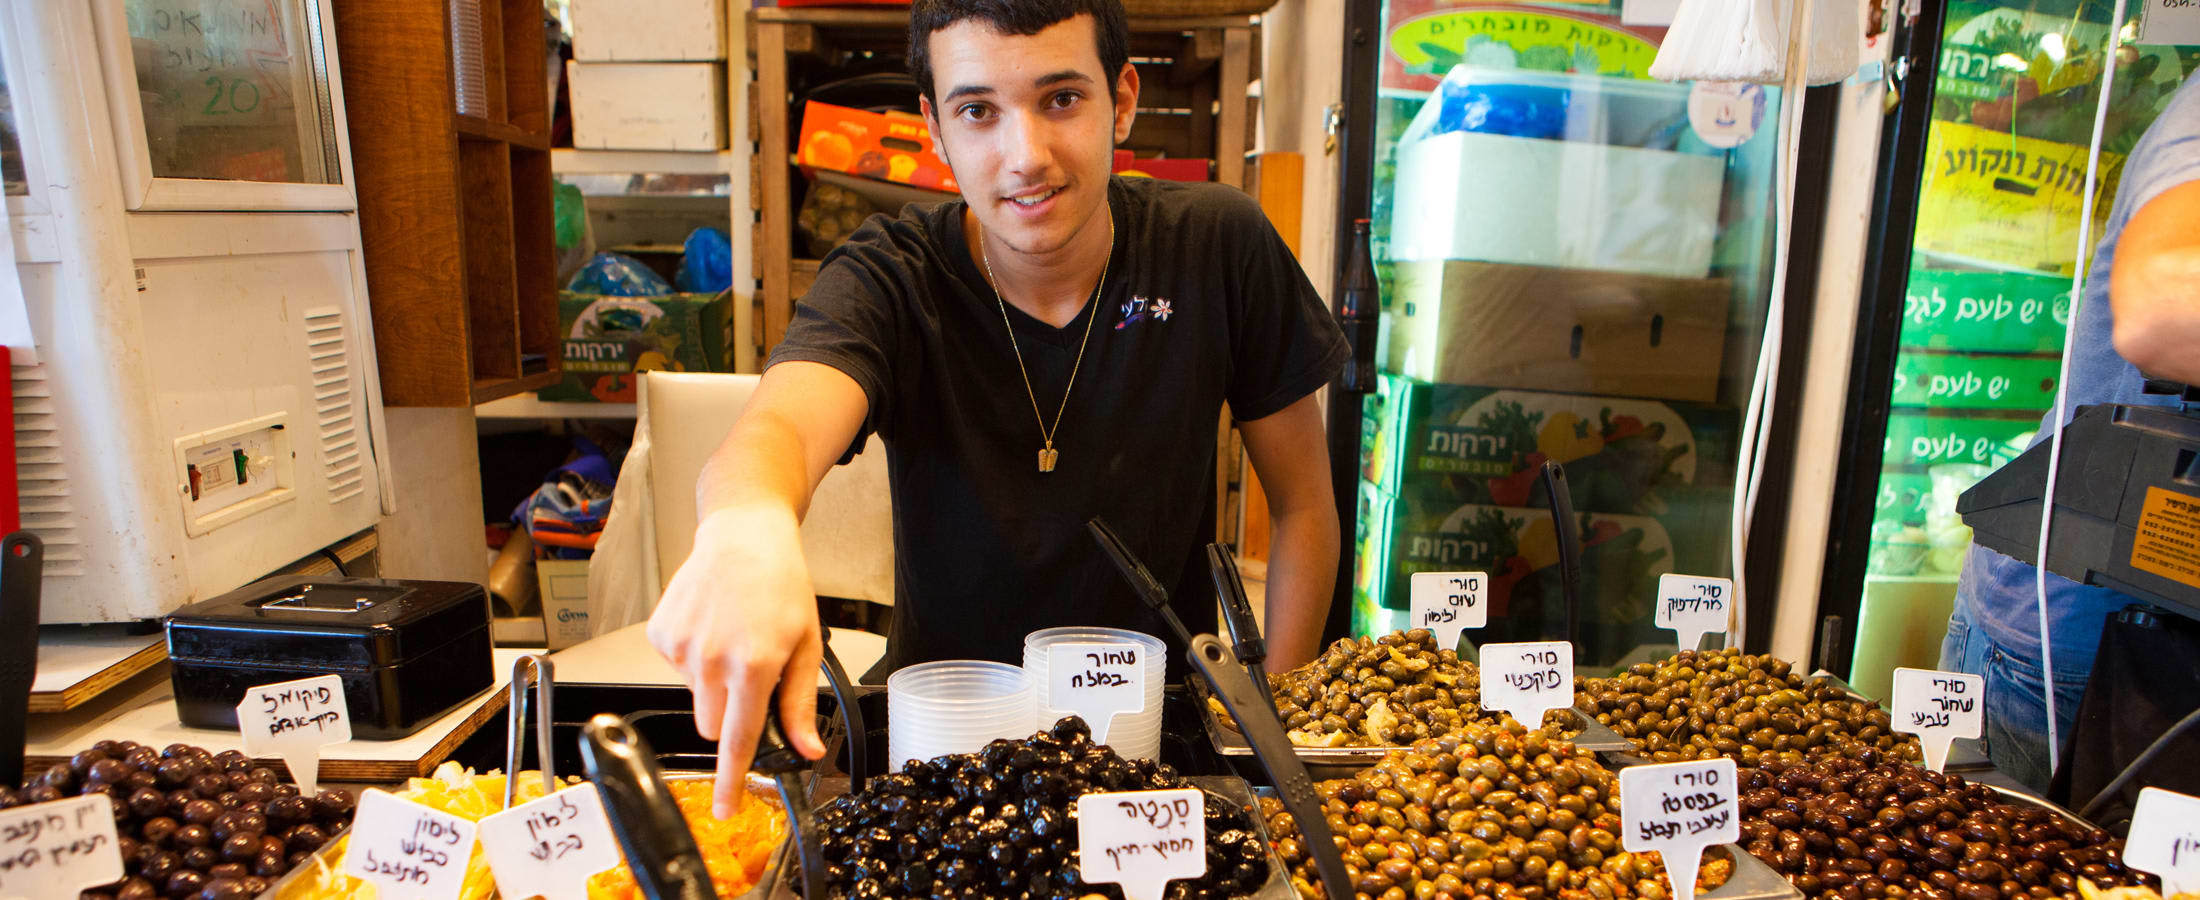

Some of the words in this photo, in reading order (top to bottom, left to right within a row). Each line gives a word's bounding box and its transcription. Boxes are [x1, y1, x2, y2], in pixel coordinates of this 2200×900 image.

[1430, 16, 1551, 35] מובחרים
[1566, 25, 1642, 54] ירקות
[202, 76, 259, 116] 20
[1954, 294, 2013, 322] טעם
[2020, 298, 2043, 324] יש
[564, 342, 624, 361] ירקות
[1928, 371, 1982, 398] טעם
[1988, 376, 2010, 400] יש
[1427, 431, 1507, 458] ירקות
[1912, 432, 1966, 460] טעם
[1972, 437, 1995, 461] יש
[1410, 536, 1488, 563] ירקות
[1450, 578, 1478, 591] סורי
[1693, 584, 1722, 598] סורי
[1448, 594, 1476, 607] שום
[1424, 608, 1457, 626] ולימון
[1087, 650, 1136, 667] שחור
[1521, 651, 1558, 665] סורי
[1072, 670, 1128, 688] במלח
[1933, 679, 1966, 693] סורי
[1931, 696, 1974, 712] שחור
[414, 812, 461, 845] לימון
[526, 794, 578, 841] לימון
